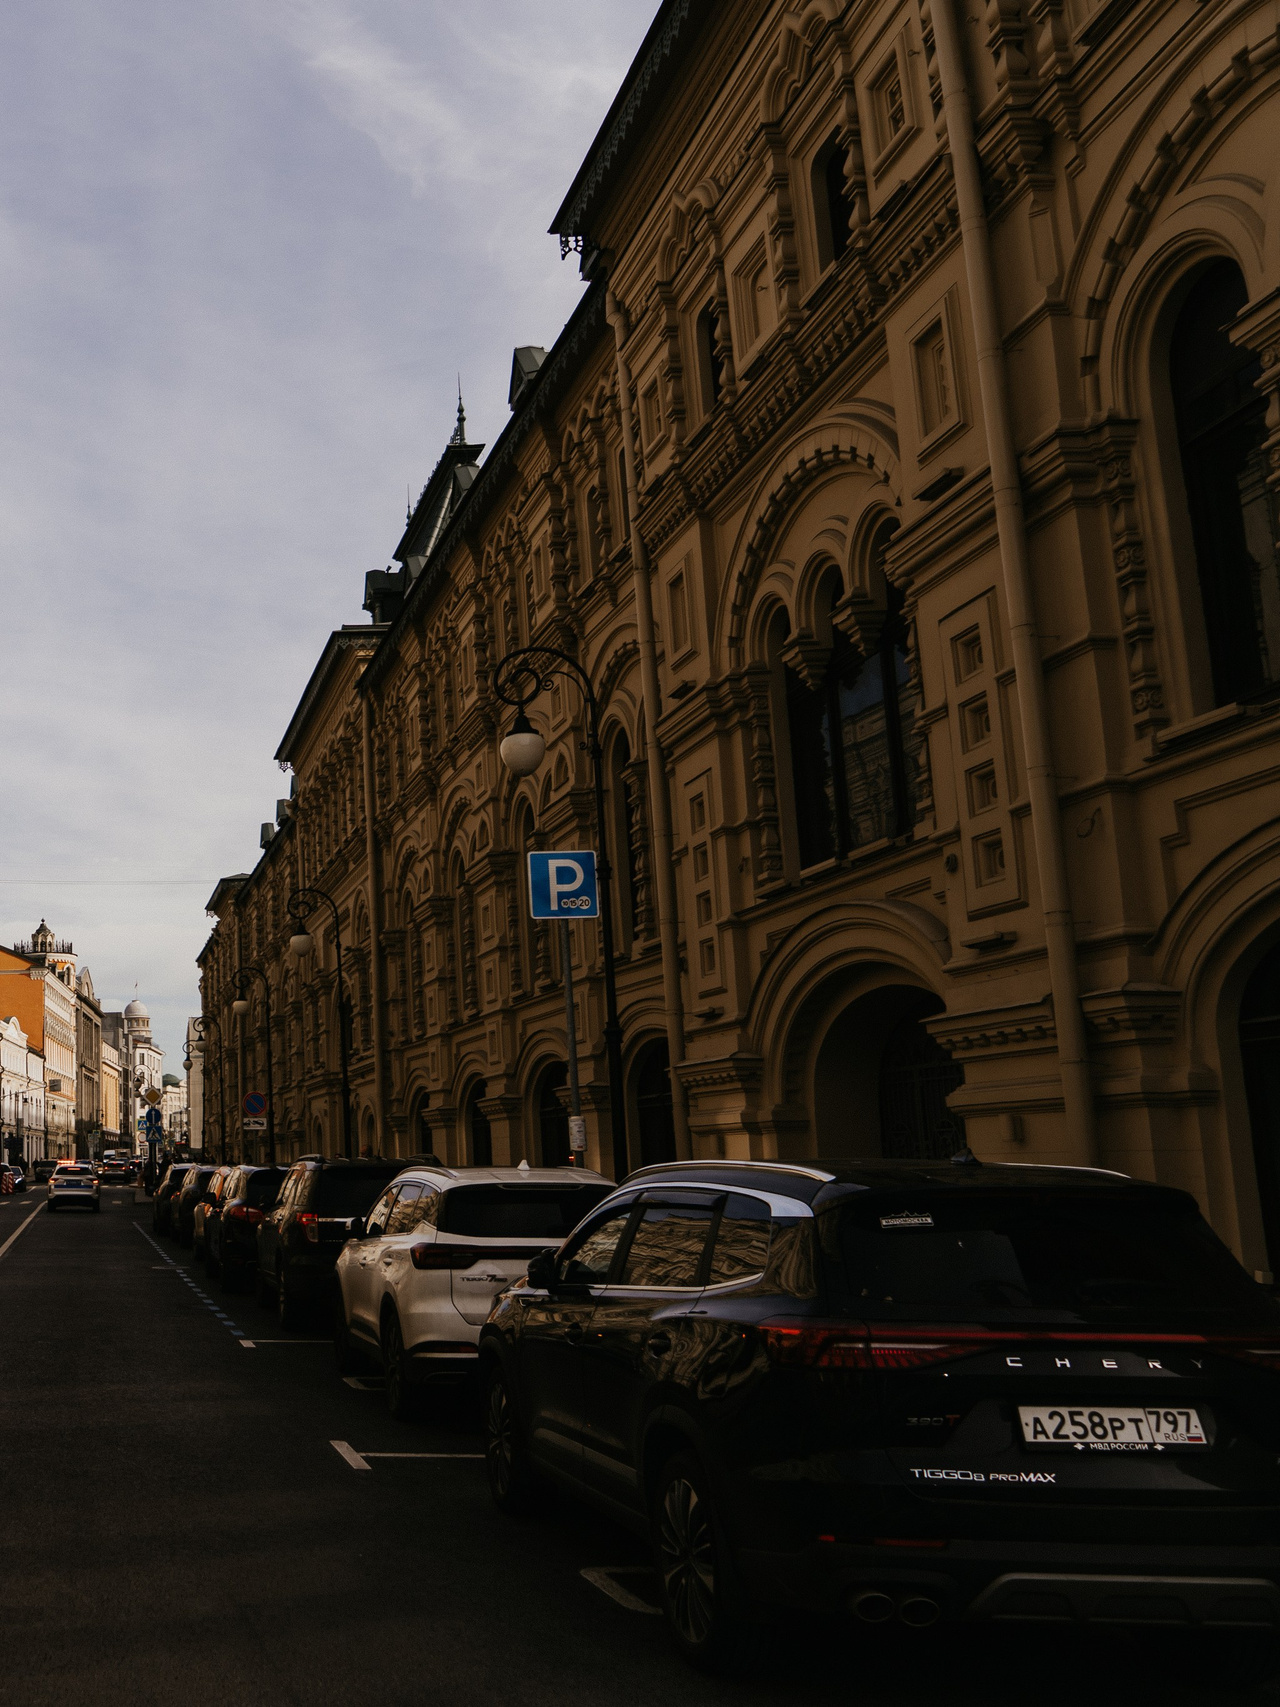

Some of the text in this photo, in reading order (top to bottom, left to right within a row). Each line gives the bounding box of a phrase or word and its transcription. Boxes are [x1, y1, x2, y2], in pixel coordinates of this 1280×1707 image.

[548, 859, 584, 911] P
[579, 898, 590, 907] 20
[1005, 1356, 1202, 1369] CHERY
[1146, 1410, 1191, 1433] 797
[1164, 1433, 1187, 1442] RUS
[1089, 1443, 1111, 1451] МВД
